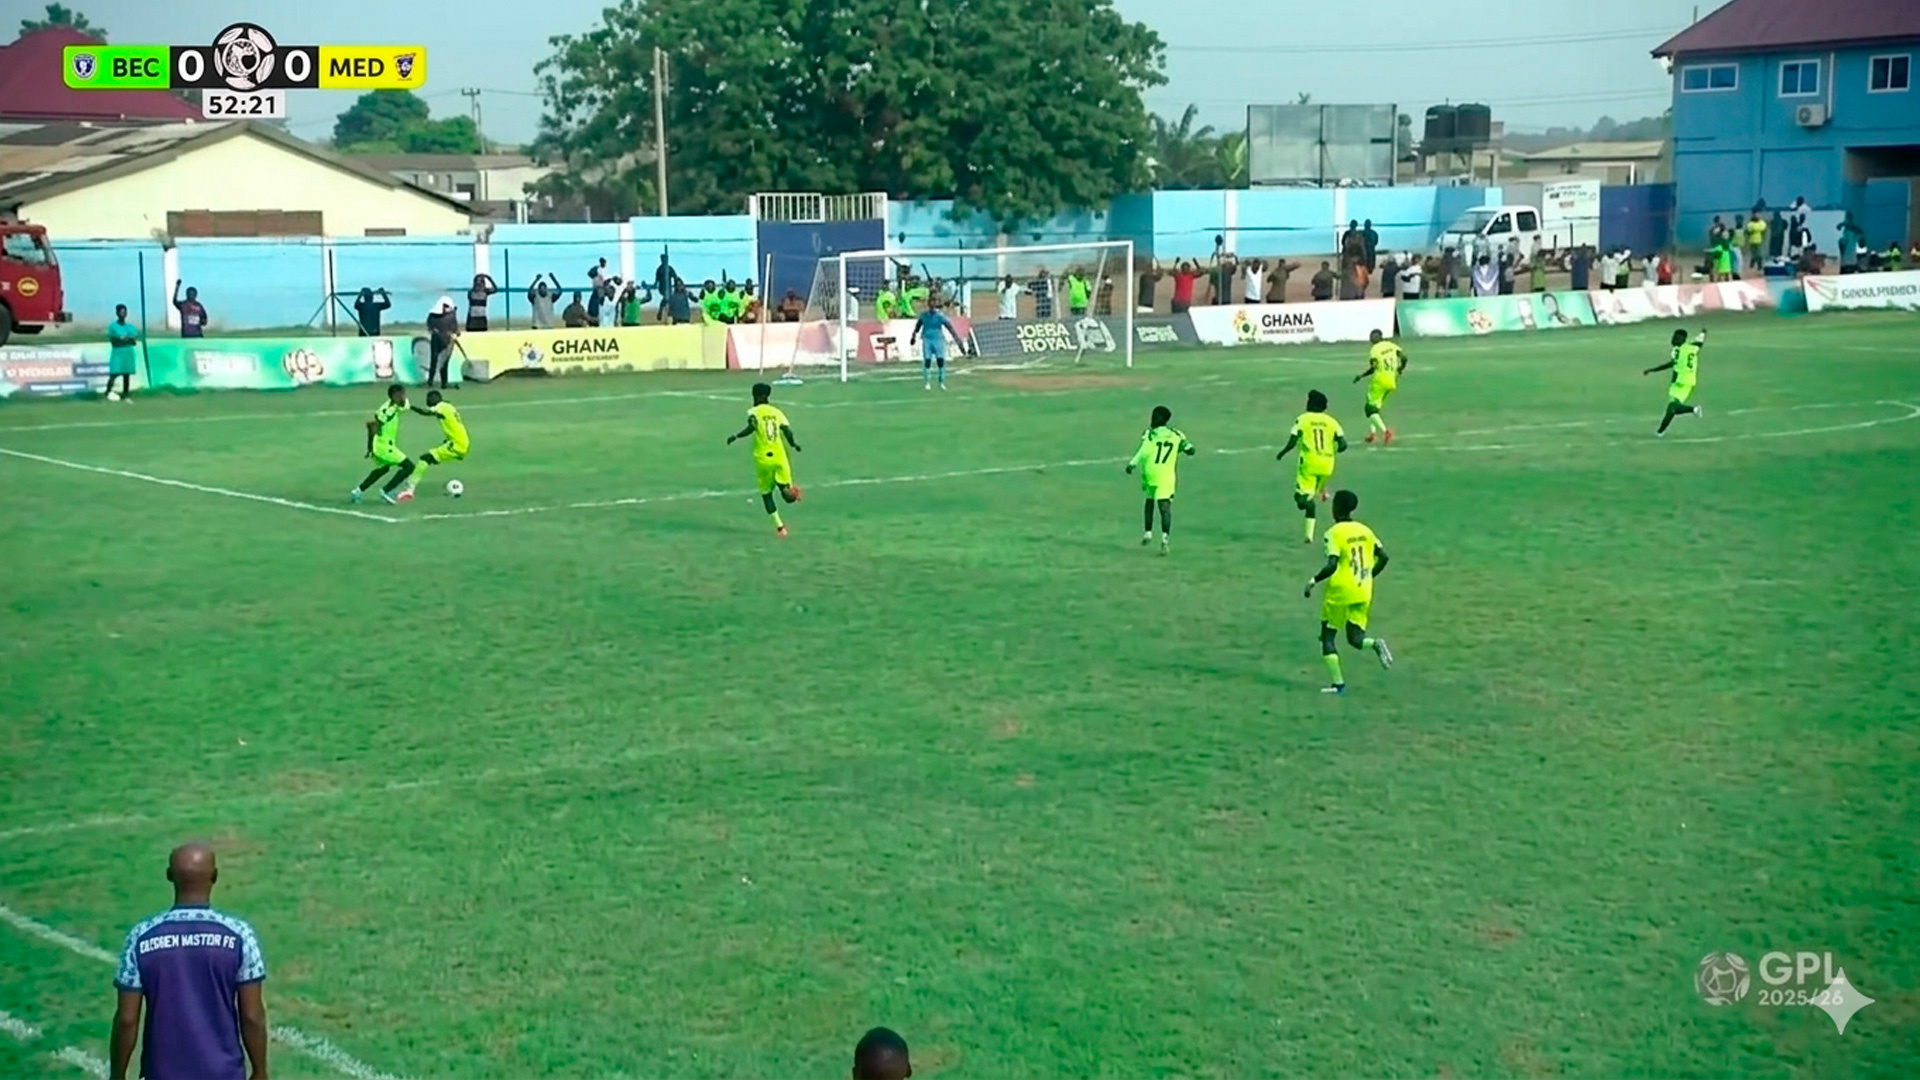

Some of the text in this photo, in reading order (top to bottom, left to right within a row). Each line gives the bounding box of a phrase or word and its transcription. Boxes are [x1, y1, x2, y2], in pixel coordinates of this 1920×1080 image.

[1261, 312, 1314, 328] GHANA
[551, 337, 620, 355] GHANA
[1020, 336, 1078, 353] ROYAL
[1154, 440, 1174, 464] 17
